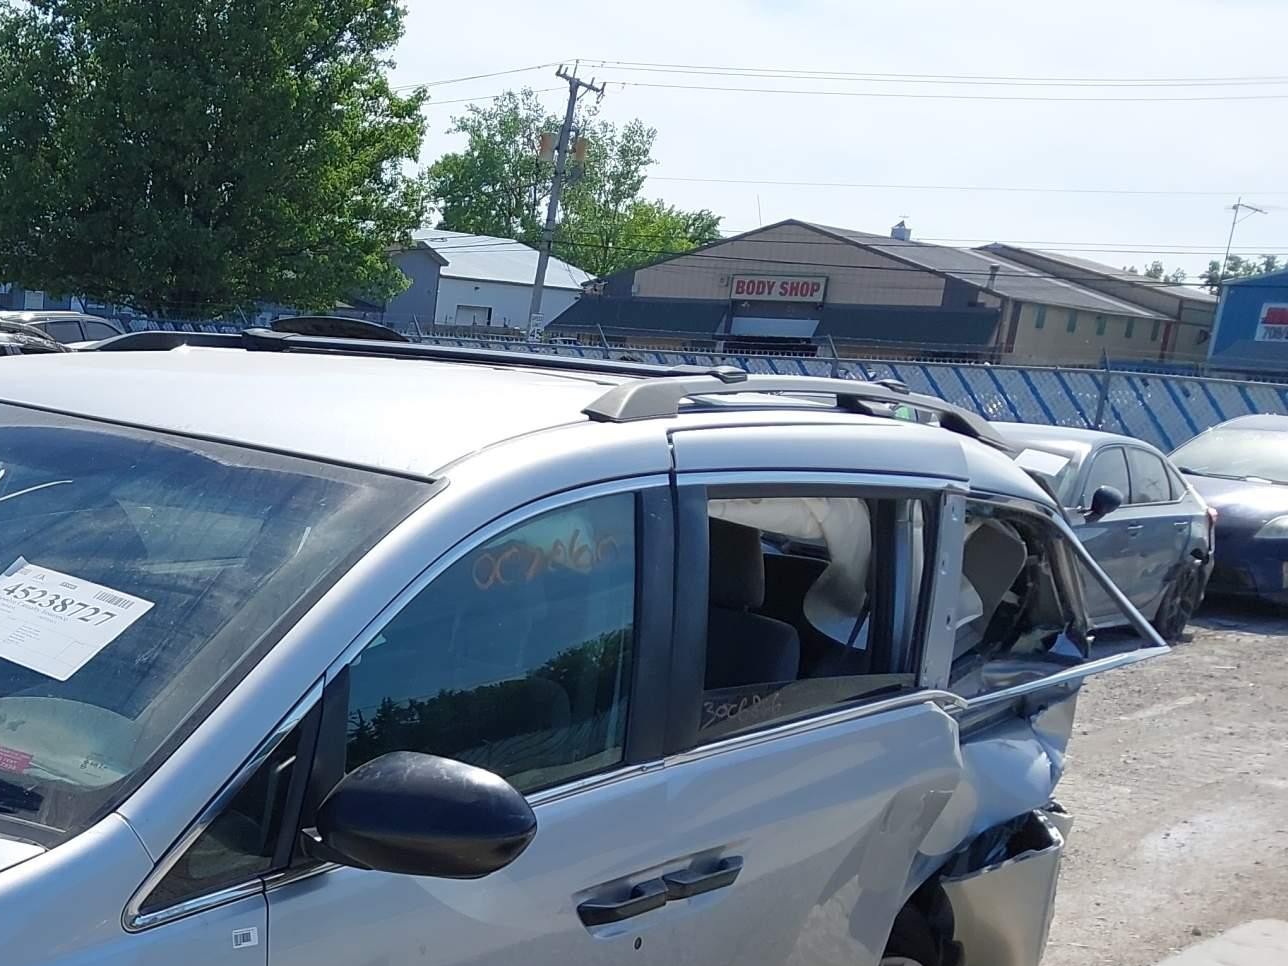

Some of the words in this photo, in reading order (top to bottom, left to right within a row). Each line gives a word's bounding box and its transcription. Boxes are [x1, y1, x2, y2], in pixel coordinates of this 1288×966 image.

[735, 279, 776, 295] BODY
[779, 281, 821, 297] SHOP
[3, 582, 116, 626] 45238727
